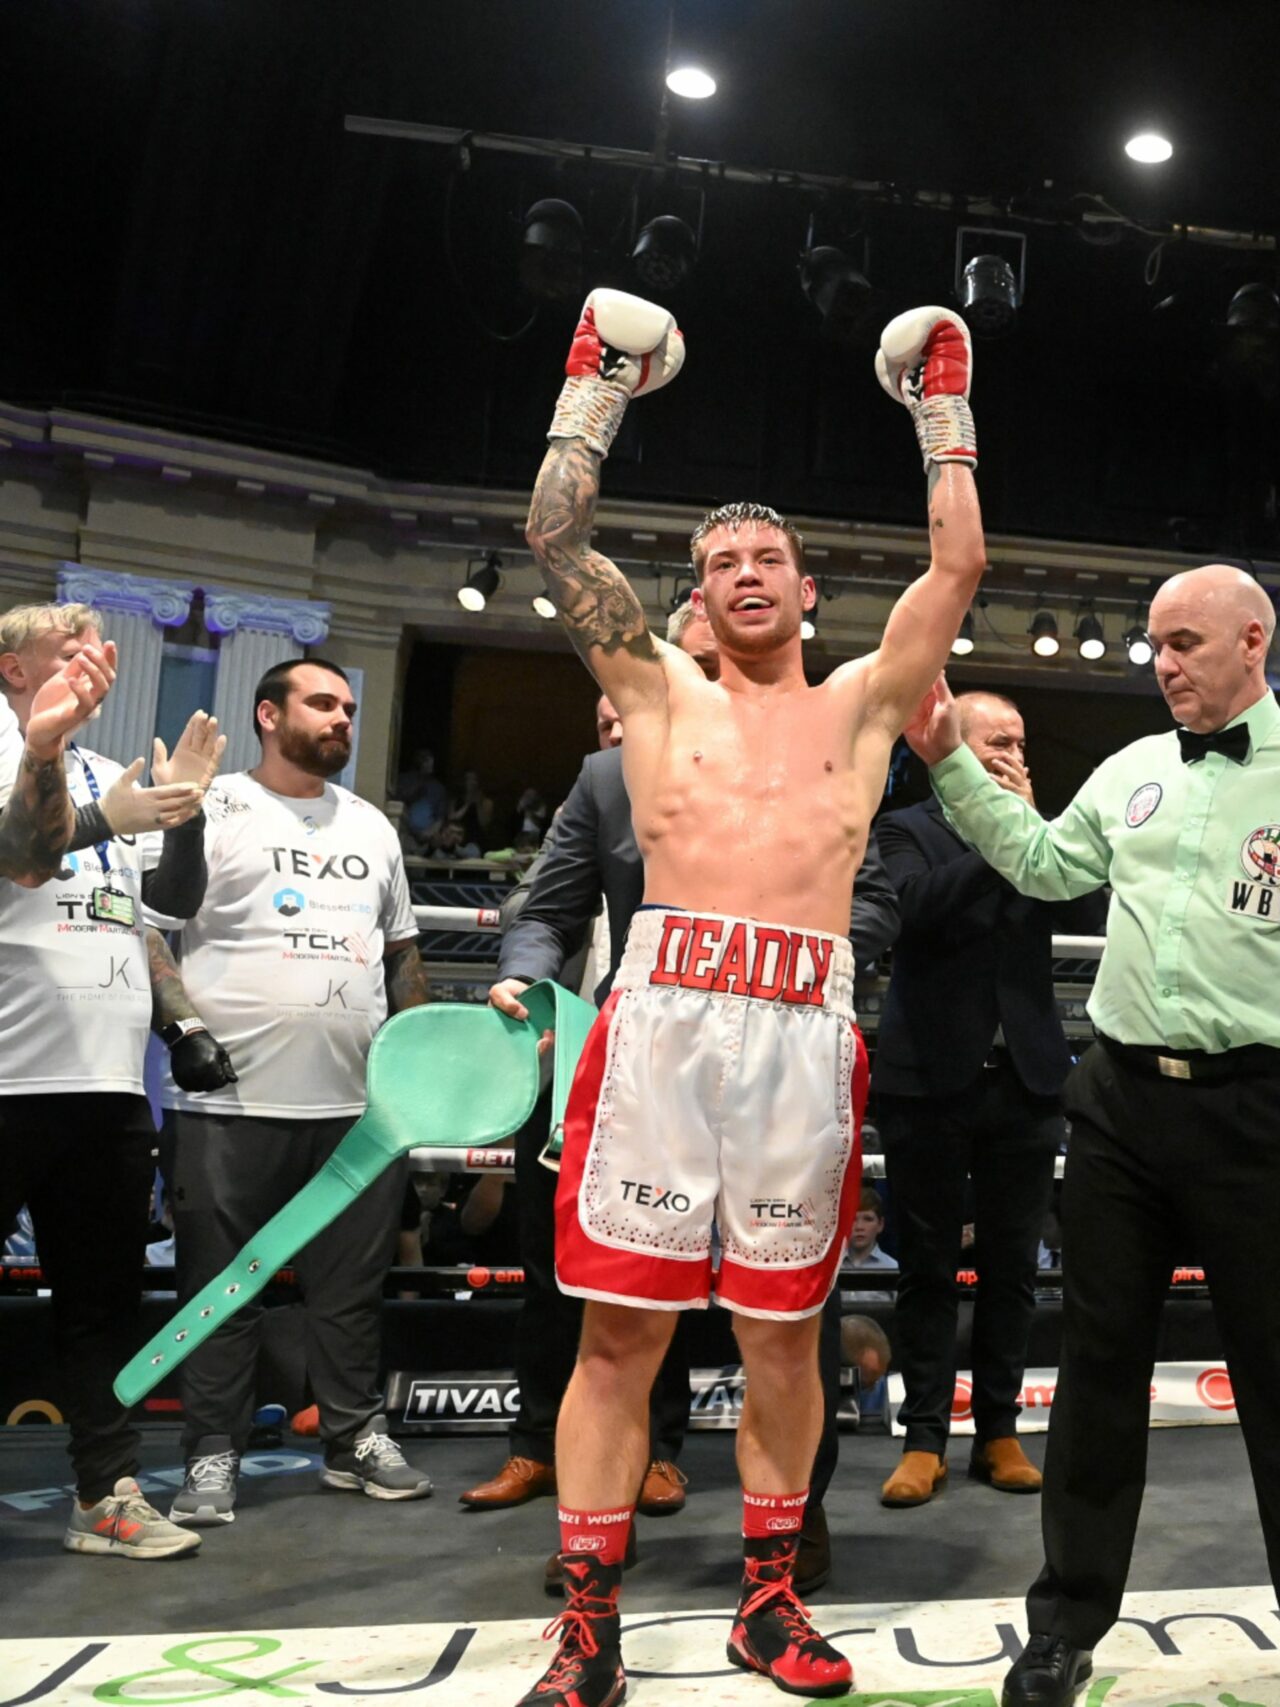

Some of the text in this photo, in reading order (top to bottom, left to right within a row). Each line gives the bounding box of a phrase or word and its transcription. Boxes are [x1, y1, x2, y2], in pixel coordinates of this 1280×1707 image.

[262, 847, 369, 880] TEXO
[283, 932, 350, 951] TCK
[99, 956, 130, 989] JK
[649, 915, 834, 1007] DEADLY
[315, 979, 348, 1009] JK
[621, 1180, 690, 1212] TEXO
[750, 1203, 803, 1218] TCK
[587, 1510, 630, 1525] WONG
